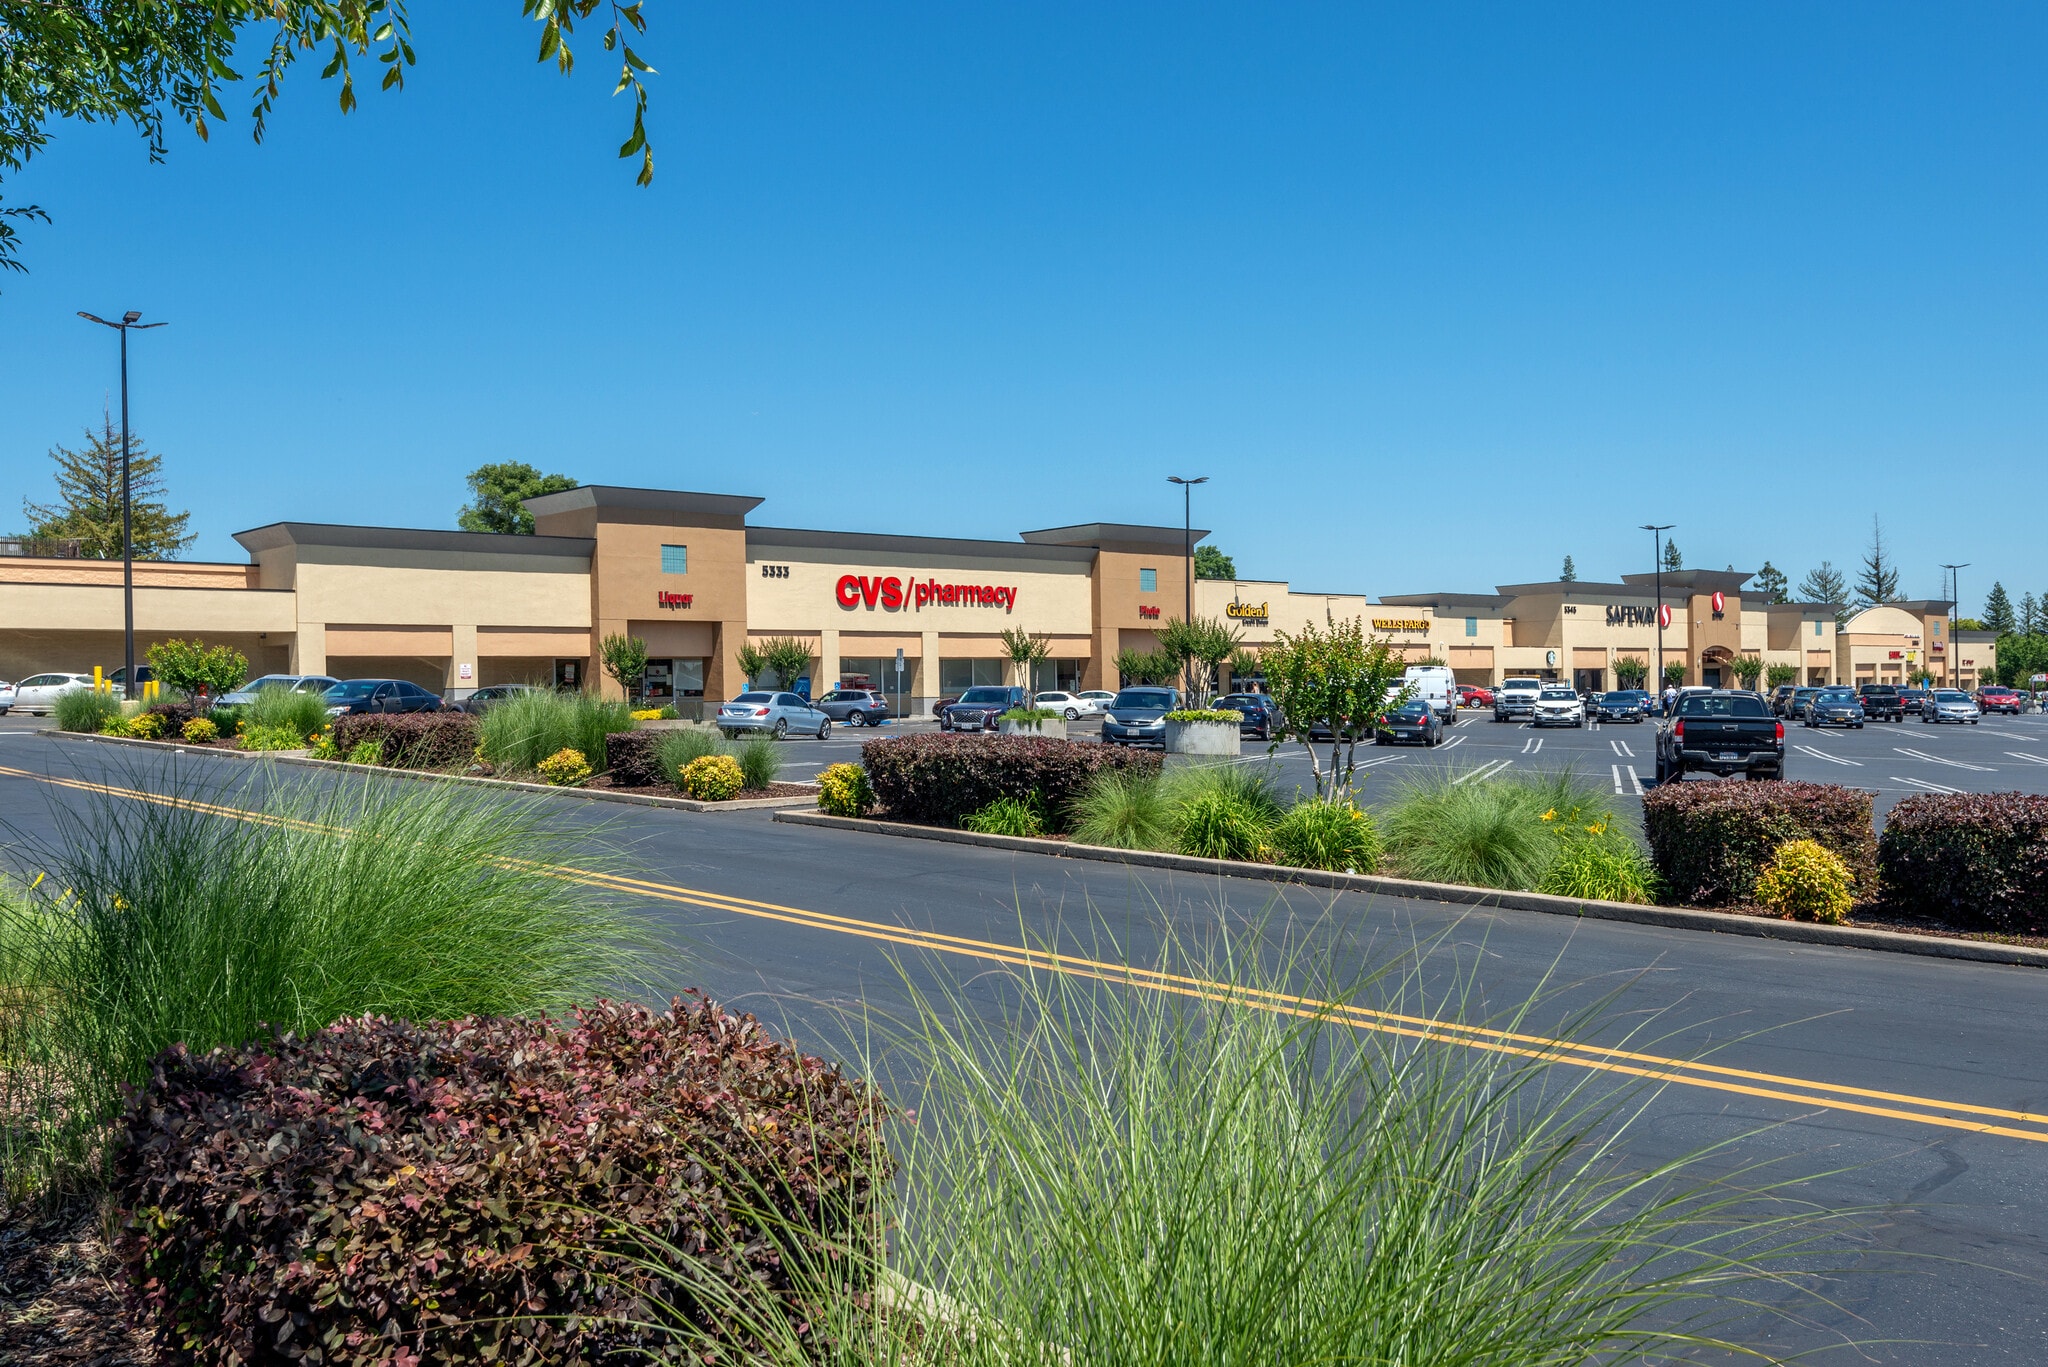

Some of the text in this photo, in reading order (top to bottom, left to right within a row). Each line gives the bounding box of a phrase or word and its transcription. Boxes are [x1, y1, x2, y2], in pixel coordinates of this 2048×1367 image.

[762, 565, 790, 578] 5333
[658, 591, 693, 607] Liquor
[1139, 605, 1160, 617] Photo
[1606, 604, 1658, 624] SAFEWAY
[1371, 619, 1430, 631] WELLS FARGO
